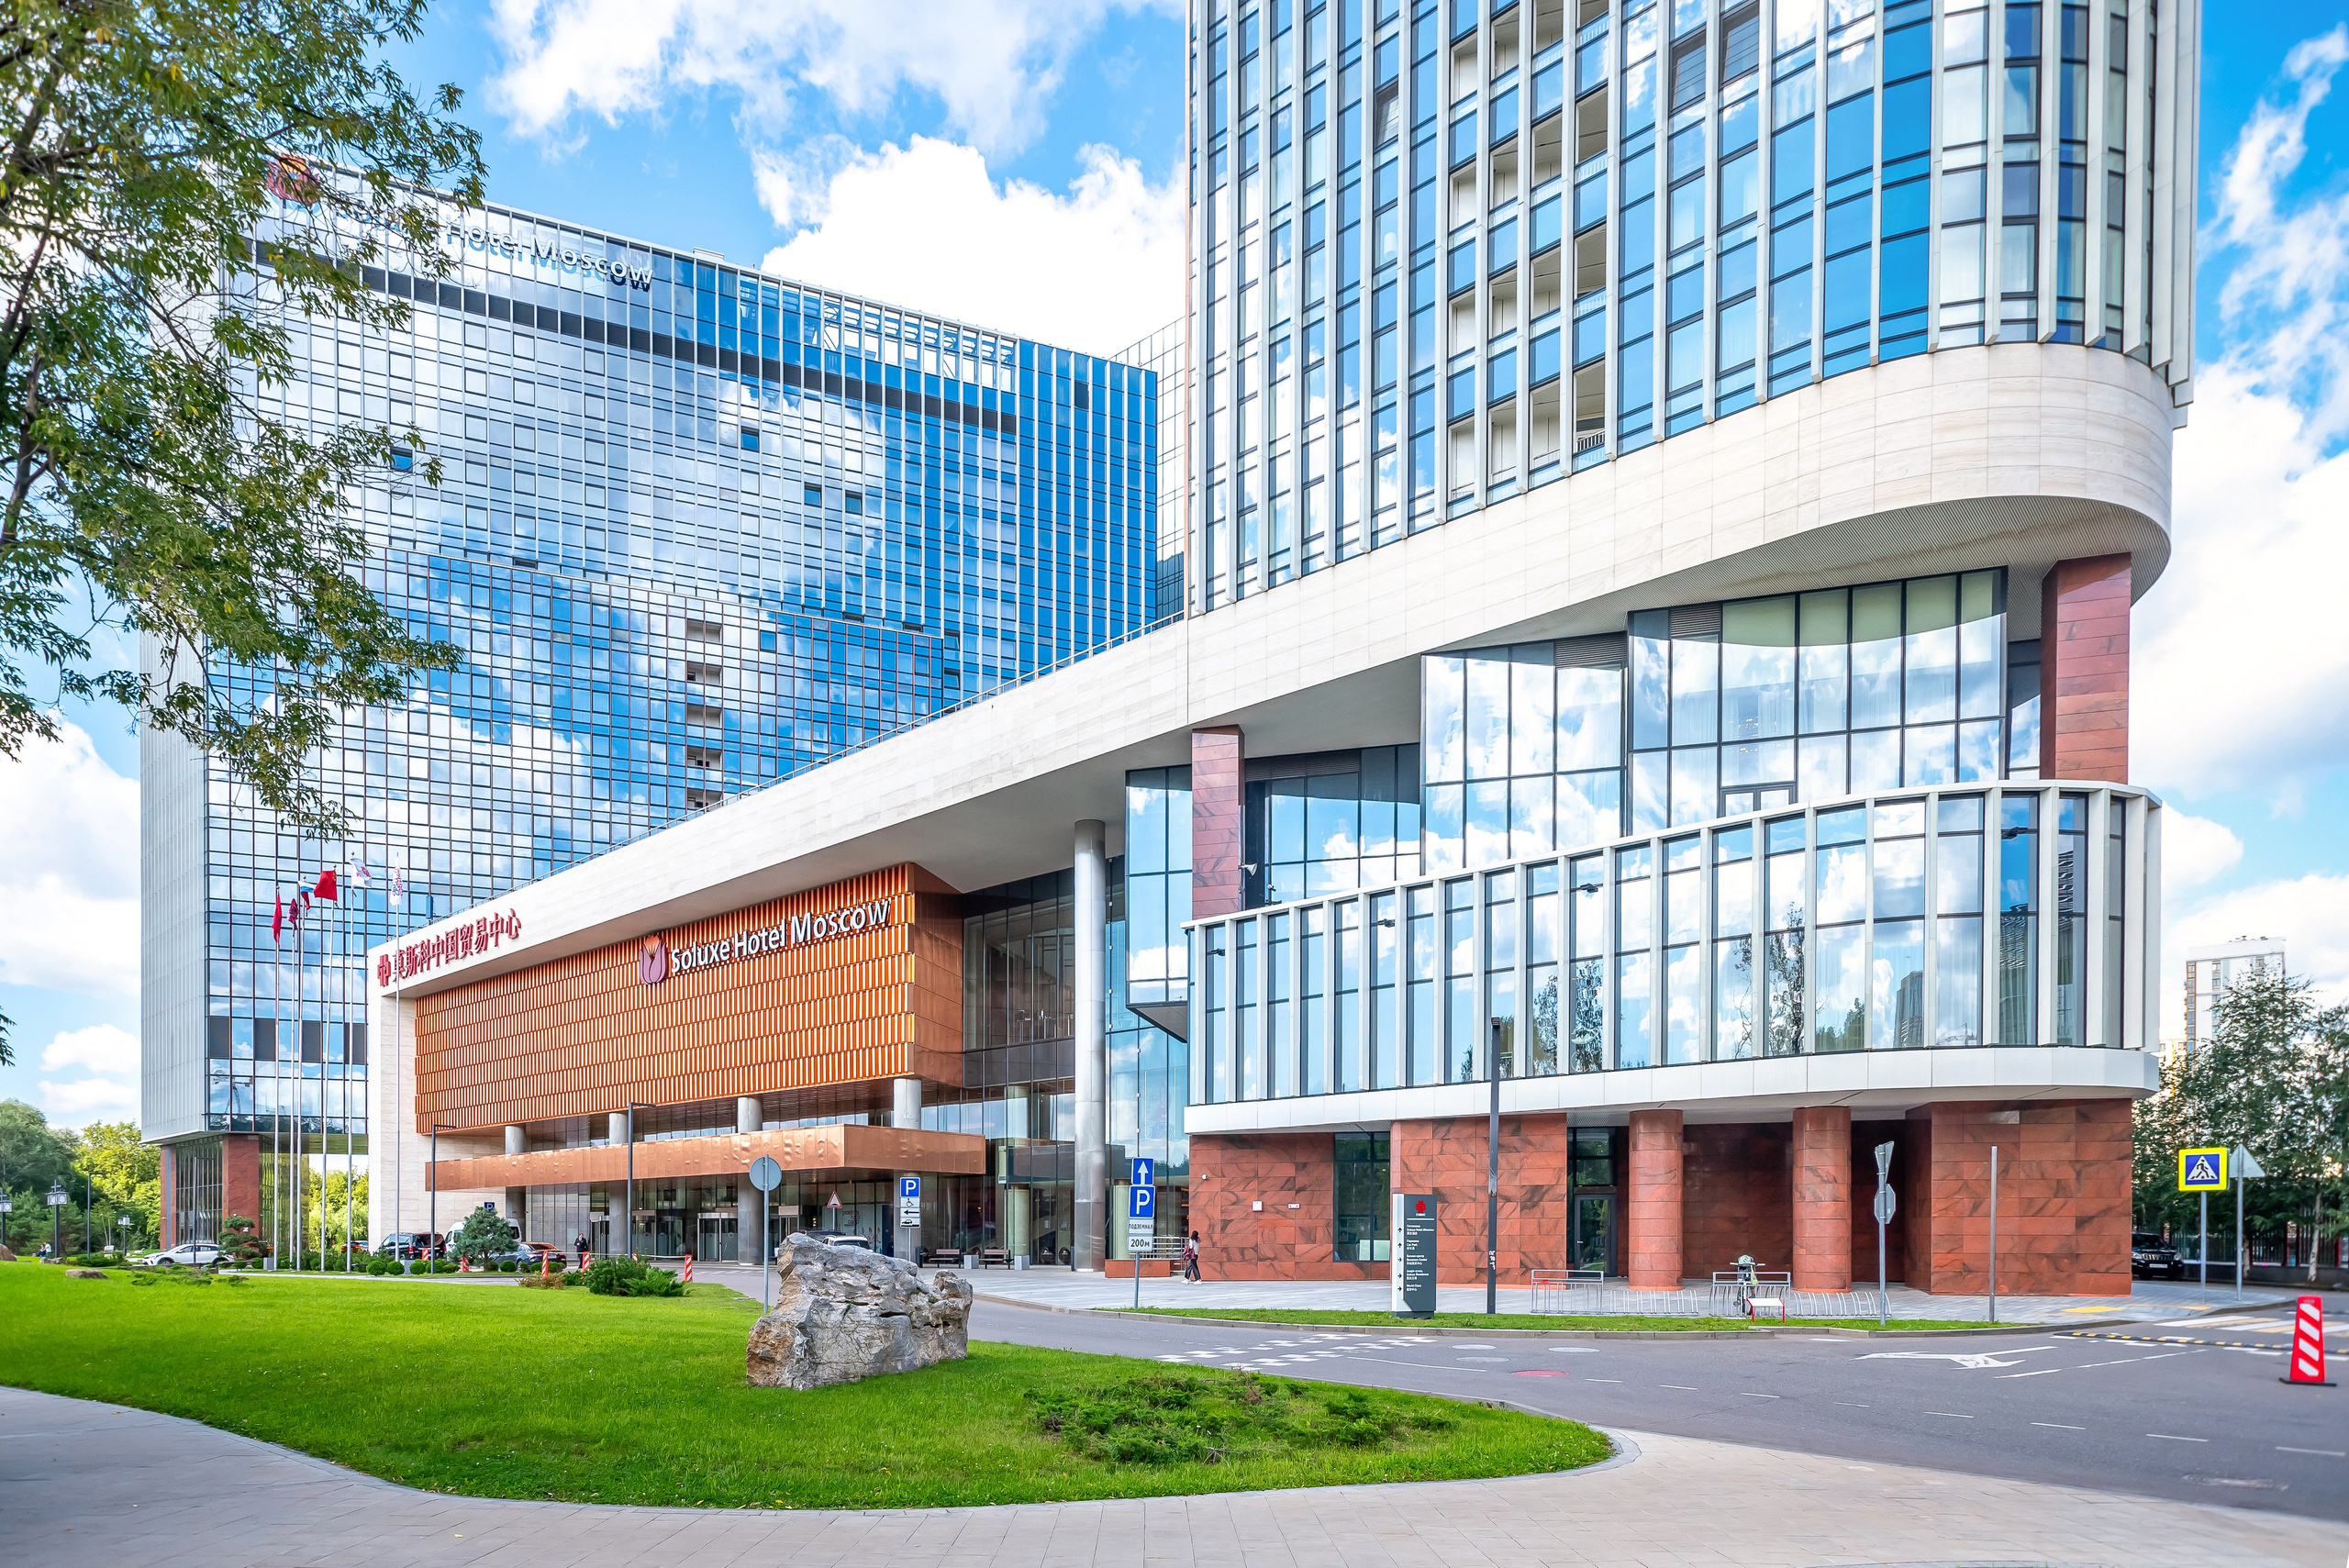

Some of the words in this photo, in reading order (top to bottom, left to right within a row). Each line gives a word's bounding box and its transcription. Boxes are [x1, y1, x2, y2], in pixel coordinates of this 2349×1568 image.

[446, 214, 523, 252] Hotel
[530, 234, 653, 284] Moscow
[392, 907, 522, 984] 莫斯科中国贸易中心
[671, 940, 730, 973] Soluxe
[734, 918, 785, 960] Hotel
[790, 899, 891, 944] Moscow
[906, 1180, 917, 1195] P
[1136, 1189, 1151, 1215] P
